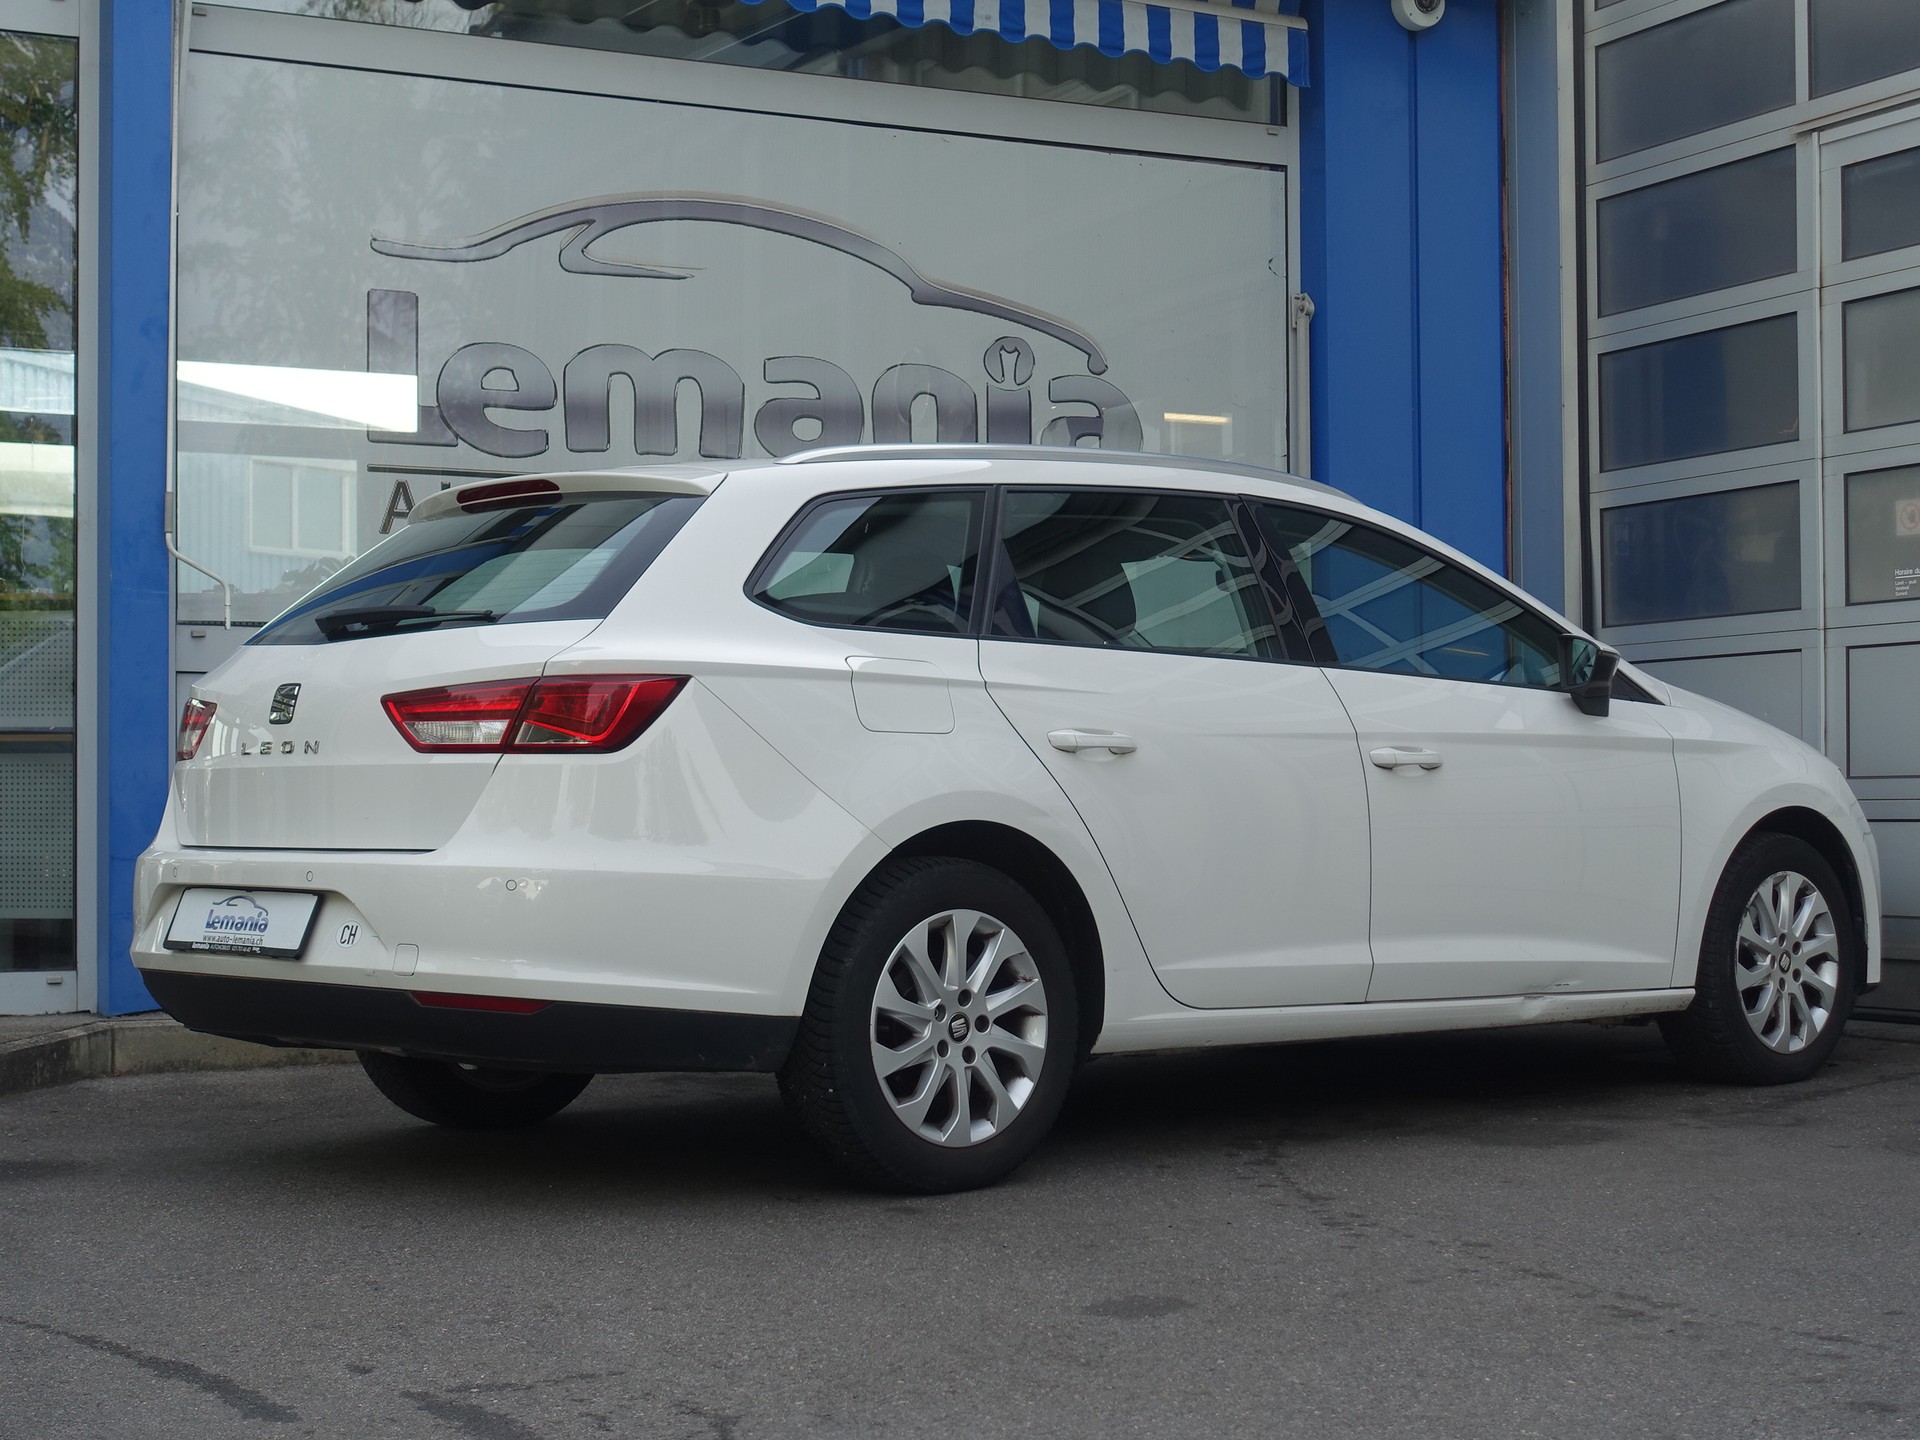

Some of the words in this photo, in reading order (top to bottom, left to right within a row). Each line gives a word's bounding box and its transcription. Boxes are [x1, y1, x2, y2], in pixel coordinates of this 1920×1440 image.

[367, 288, 1144, 459] Lemania
[241, 740, 320, 755] LEON
[205, 909, 269, 933] Lemania
[203, 934, 264, 946] www.auto-lemania.ch
[340, 924, 359, 945] CH
